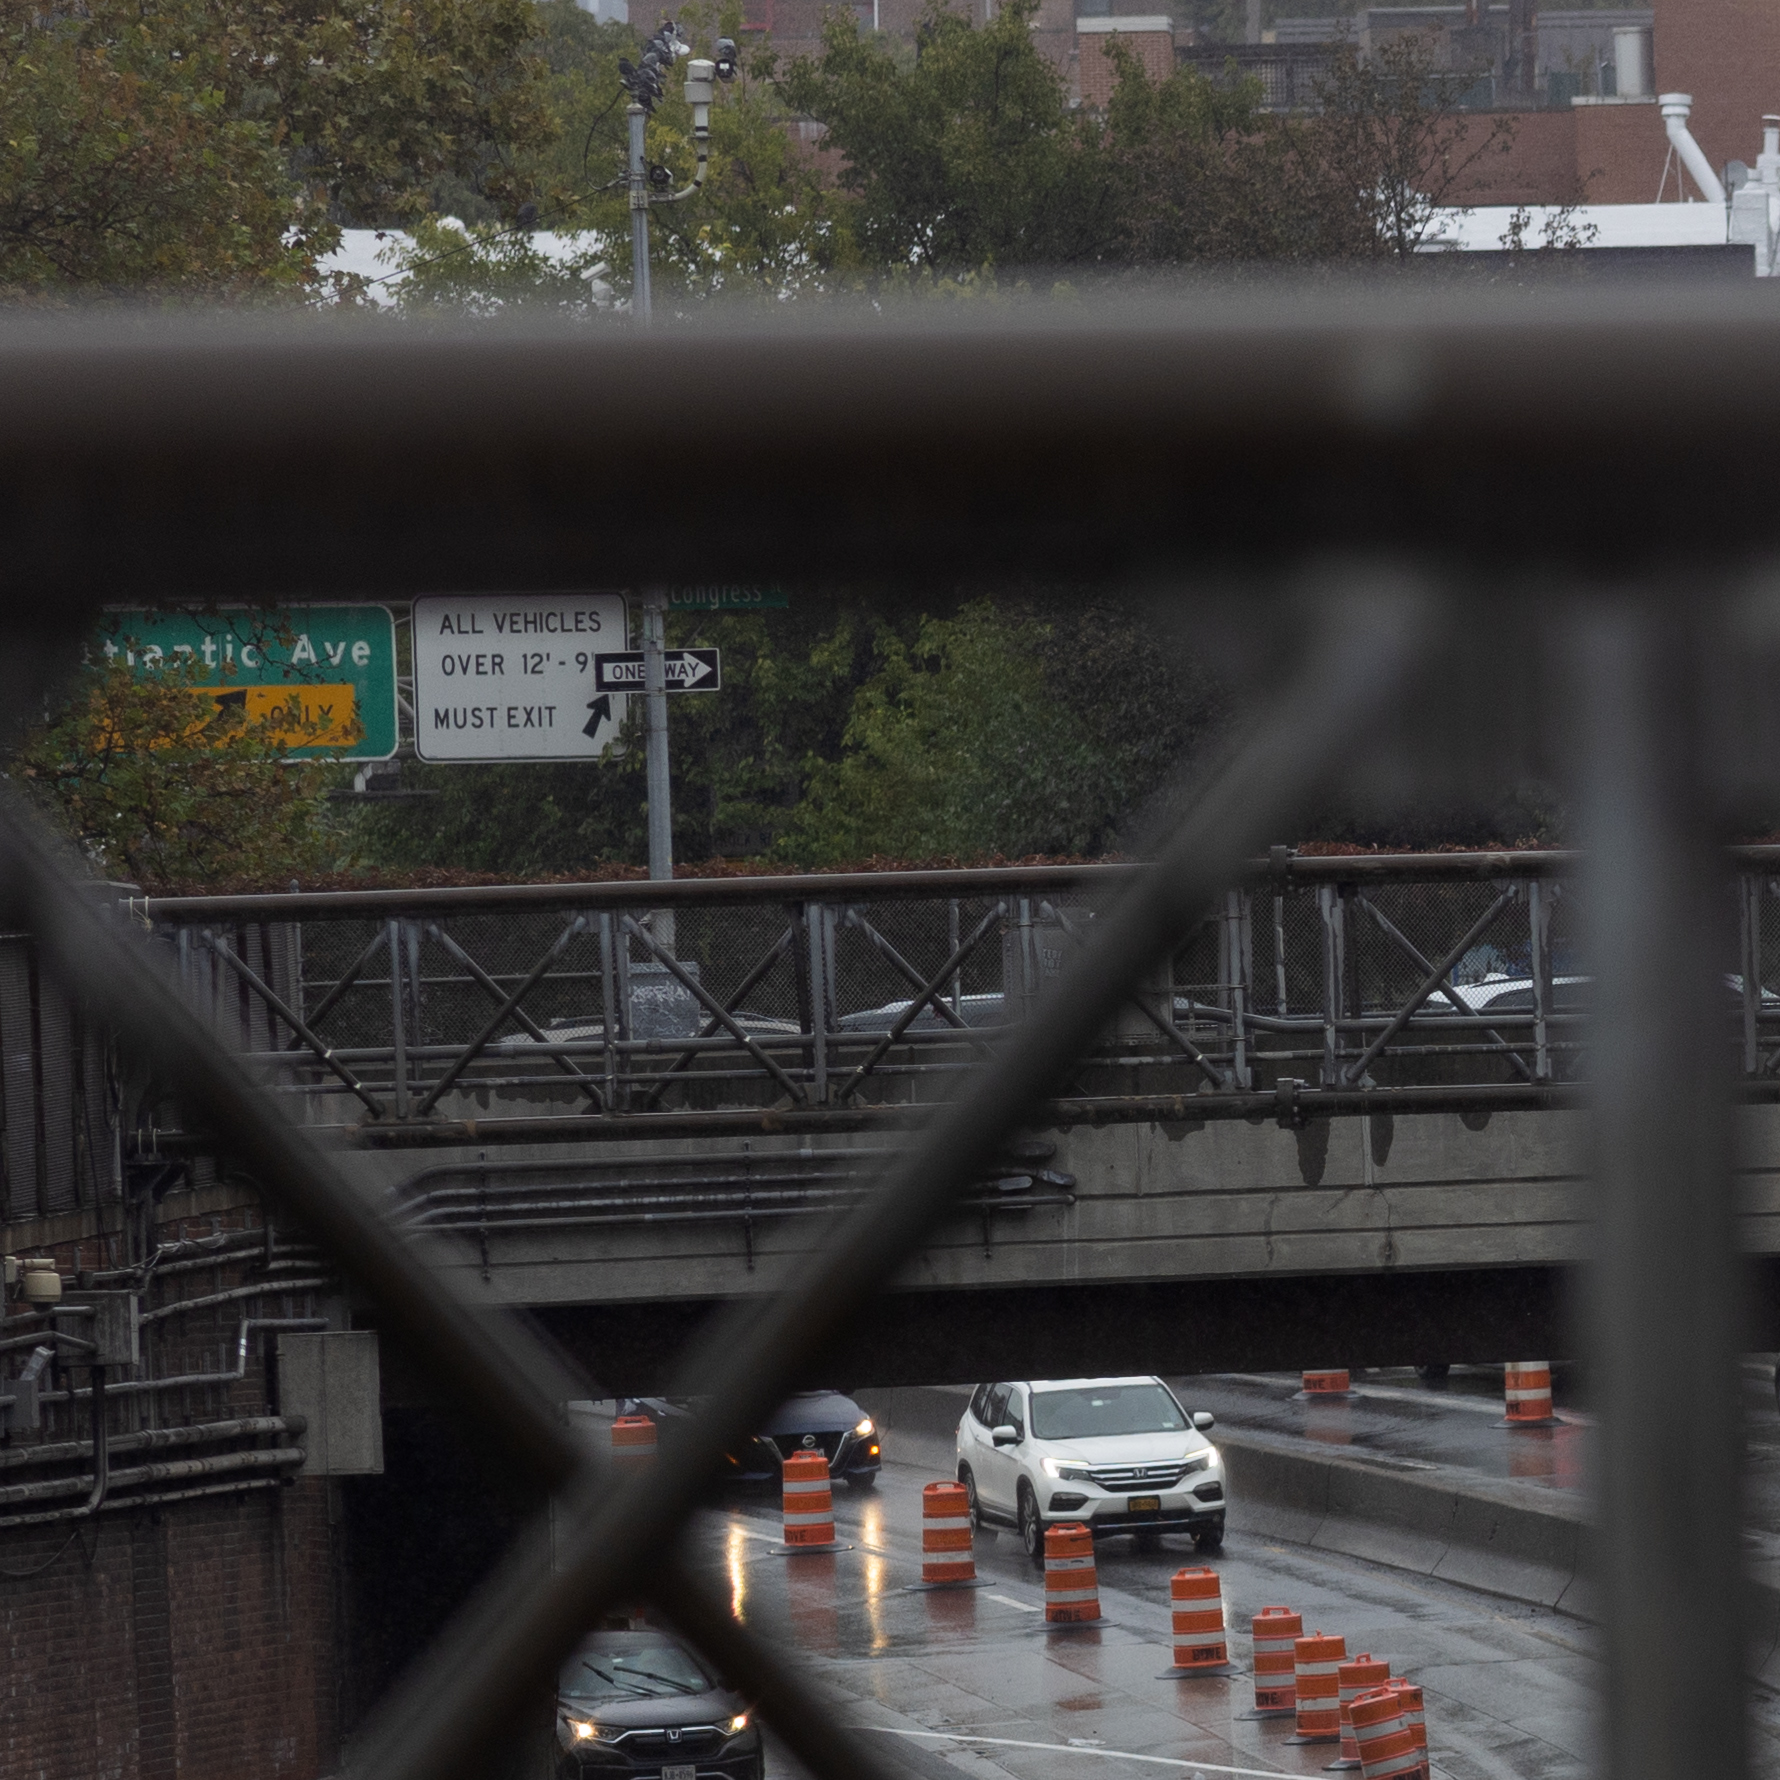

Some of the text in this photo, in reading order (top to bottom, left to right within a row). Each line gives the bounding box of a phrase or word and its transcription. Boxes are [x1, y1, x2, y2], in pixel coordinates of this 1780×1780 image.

[440, 611, 601, 635] ALL VEHICLES
[80, 633, 371, 671] tlantic Ave
[442, 654, 505, 677] OVER
[612, 662, 700, 680] ONE WAY
[271, 703, 334, 724] OLY
[434, 706, 557, 730] MUST EXIT
